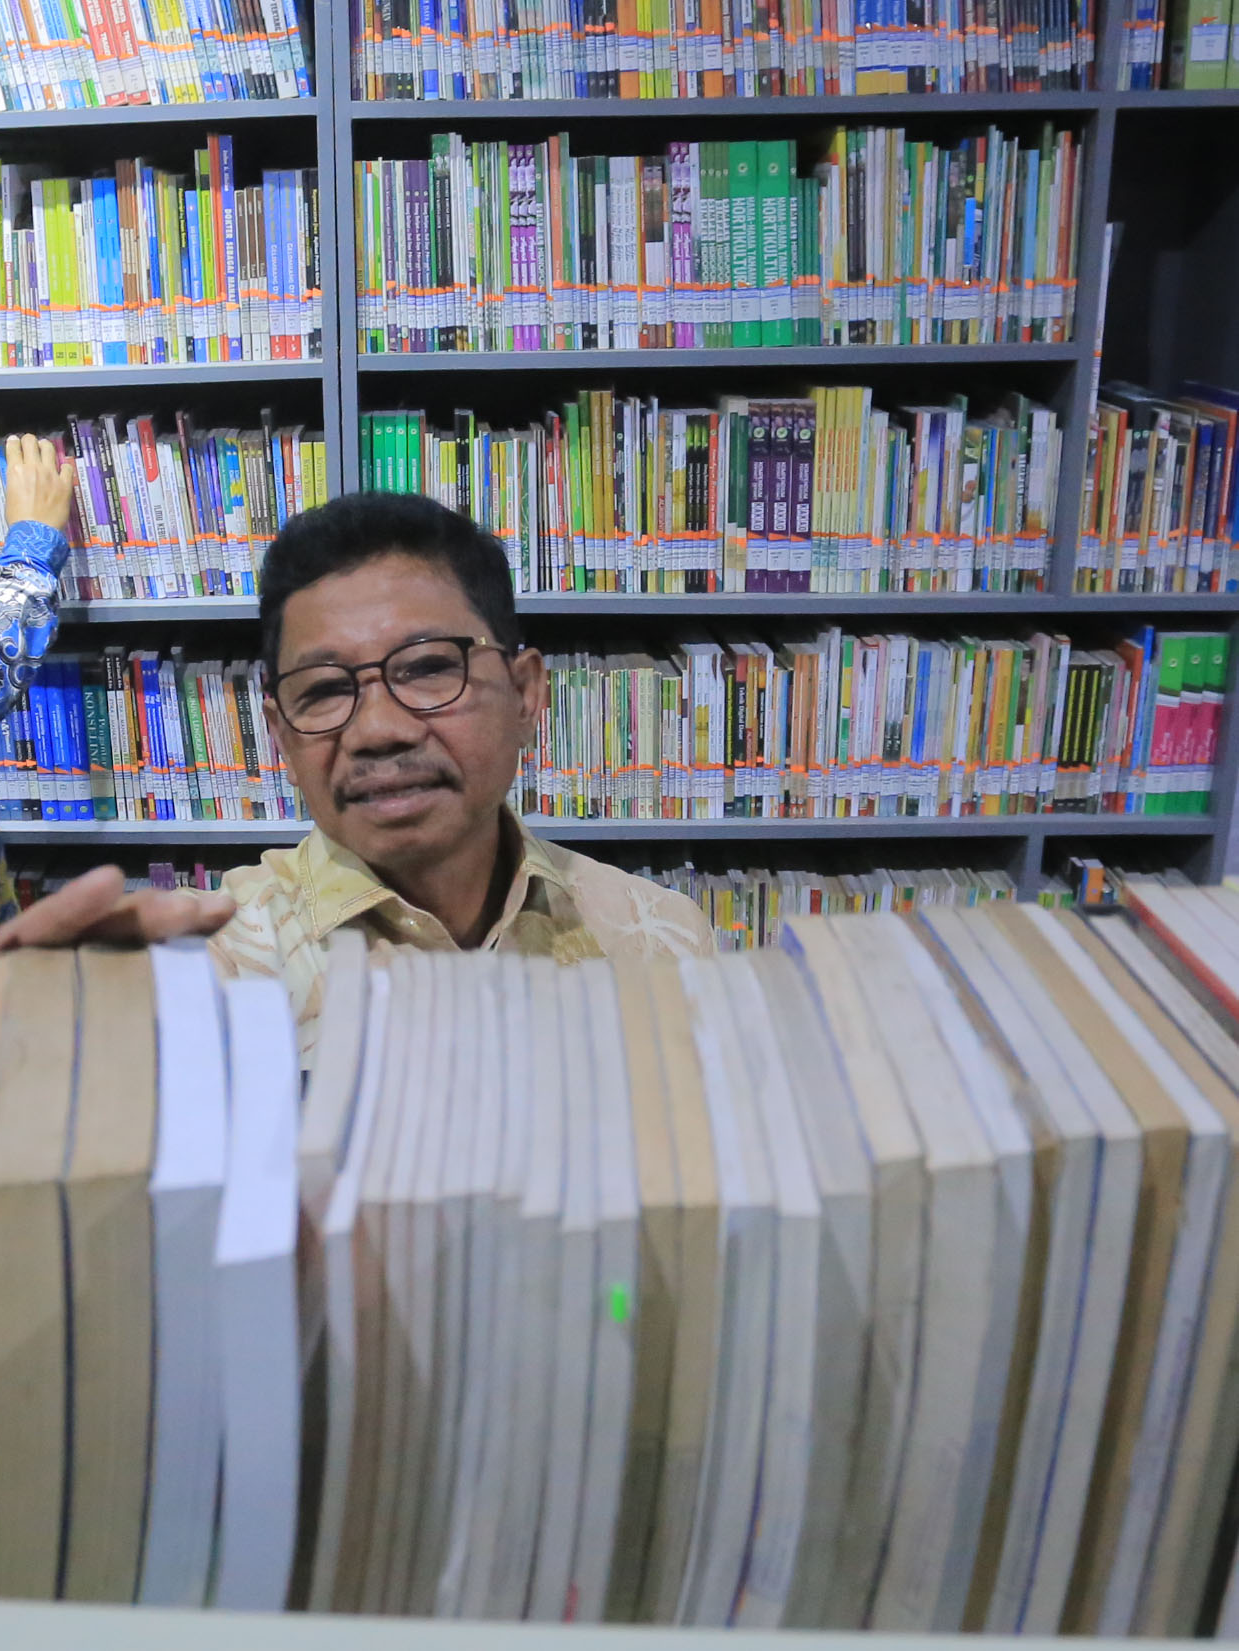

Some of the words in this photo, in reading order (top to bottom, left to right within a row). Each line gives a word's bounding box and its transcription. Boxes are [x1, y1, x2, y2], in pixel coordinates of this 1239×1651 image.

[225, 209, 234, 239] DOKTER
[746, 196, 756, 249] HAMA-HAMA
[777, 196, 787, 250] HAMA-HAMA
[763, 197, 778, 285] HORTIKULTUR
[226, 241, 234, 274] SEBAGAI
[227, 276, 236, 302] MANAJ
[153, 505, 164, 521] ILMU
[753, 503, 763, 530] KAKAO
[775, 503, 785, 530] KAKAO
[798, 505, 808, 531] KAKAO
[84, 691, 99, 767] KONSELING
